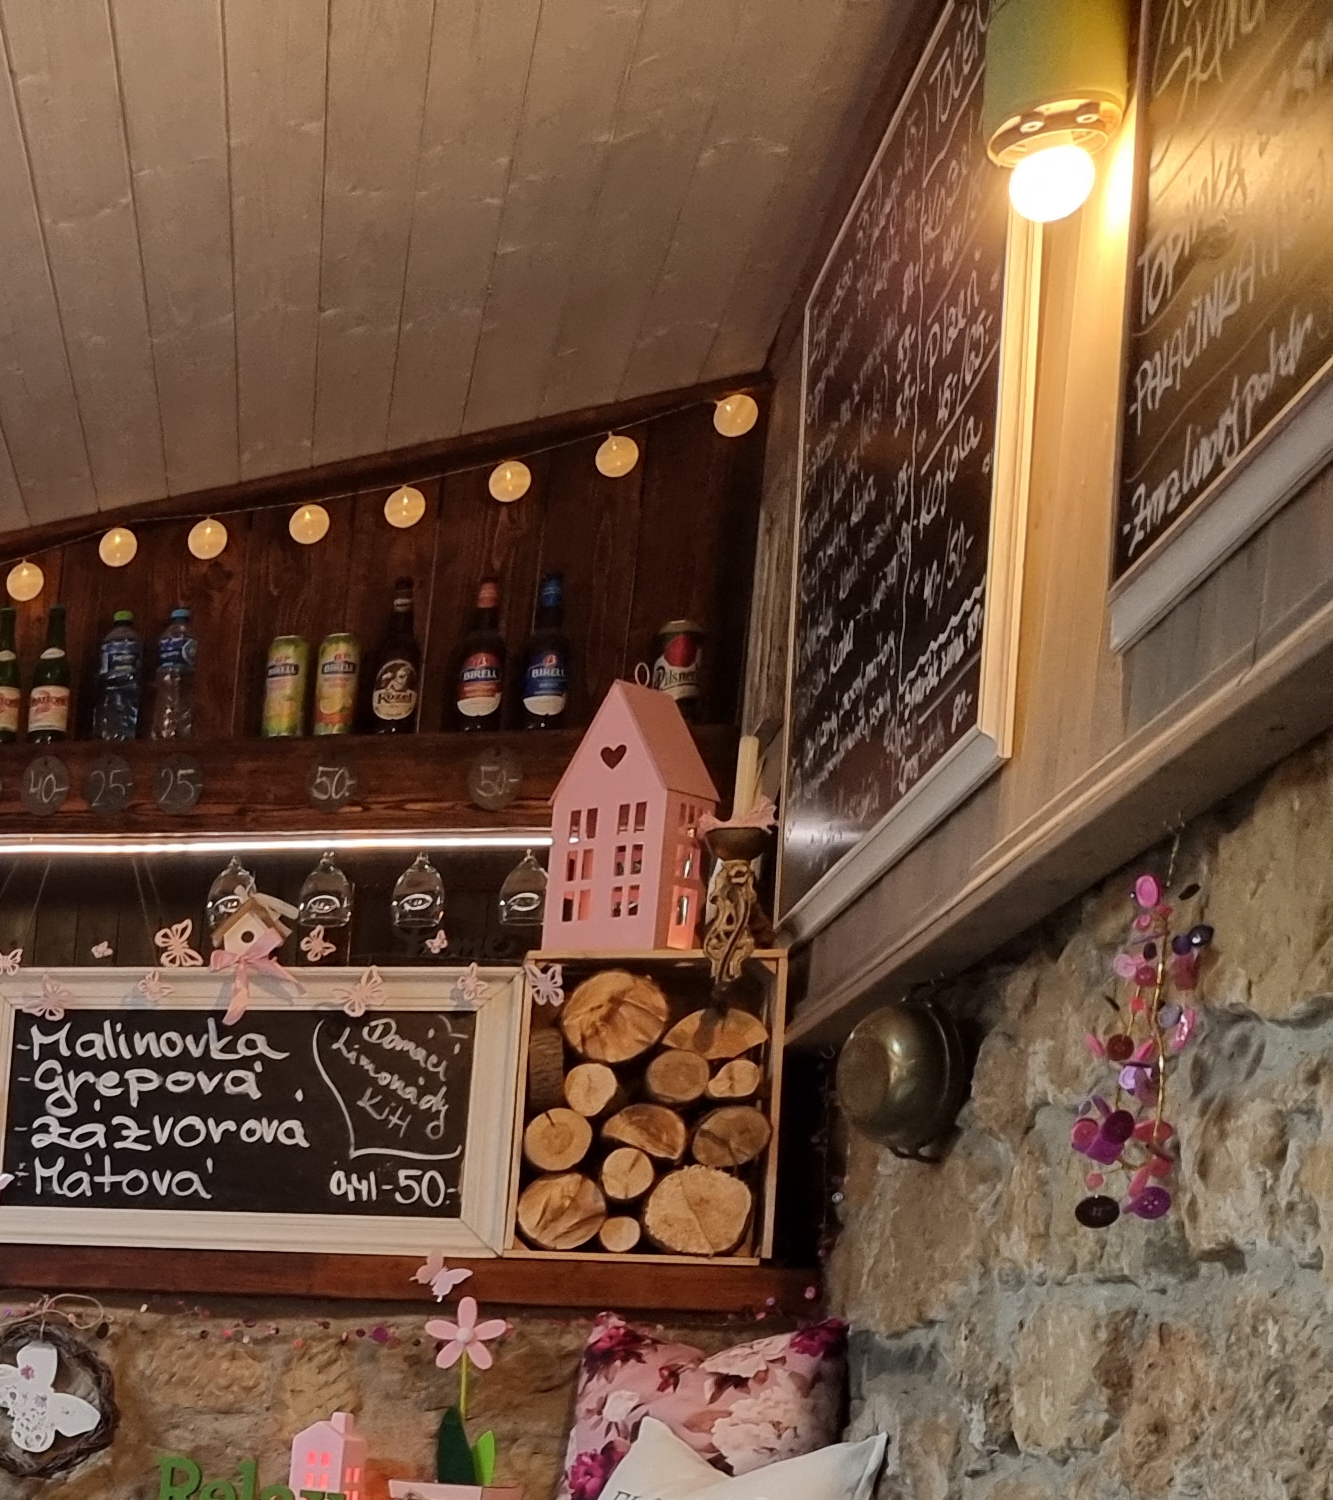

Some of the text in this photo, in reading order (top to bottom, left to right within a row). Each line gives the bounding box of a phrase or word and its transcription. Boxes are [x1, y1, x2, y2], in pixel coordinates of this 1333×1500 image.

[920, 415, 983, 540] Kofola
[464, 668, 497, 681] BIRELL
[30, 1017, 291, 1061] Malinovka
[30, 1088, 311, 1152] Zázvorová
[33, 1152, 213, 1200] Mátová
